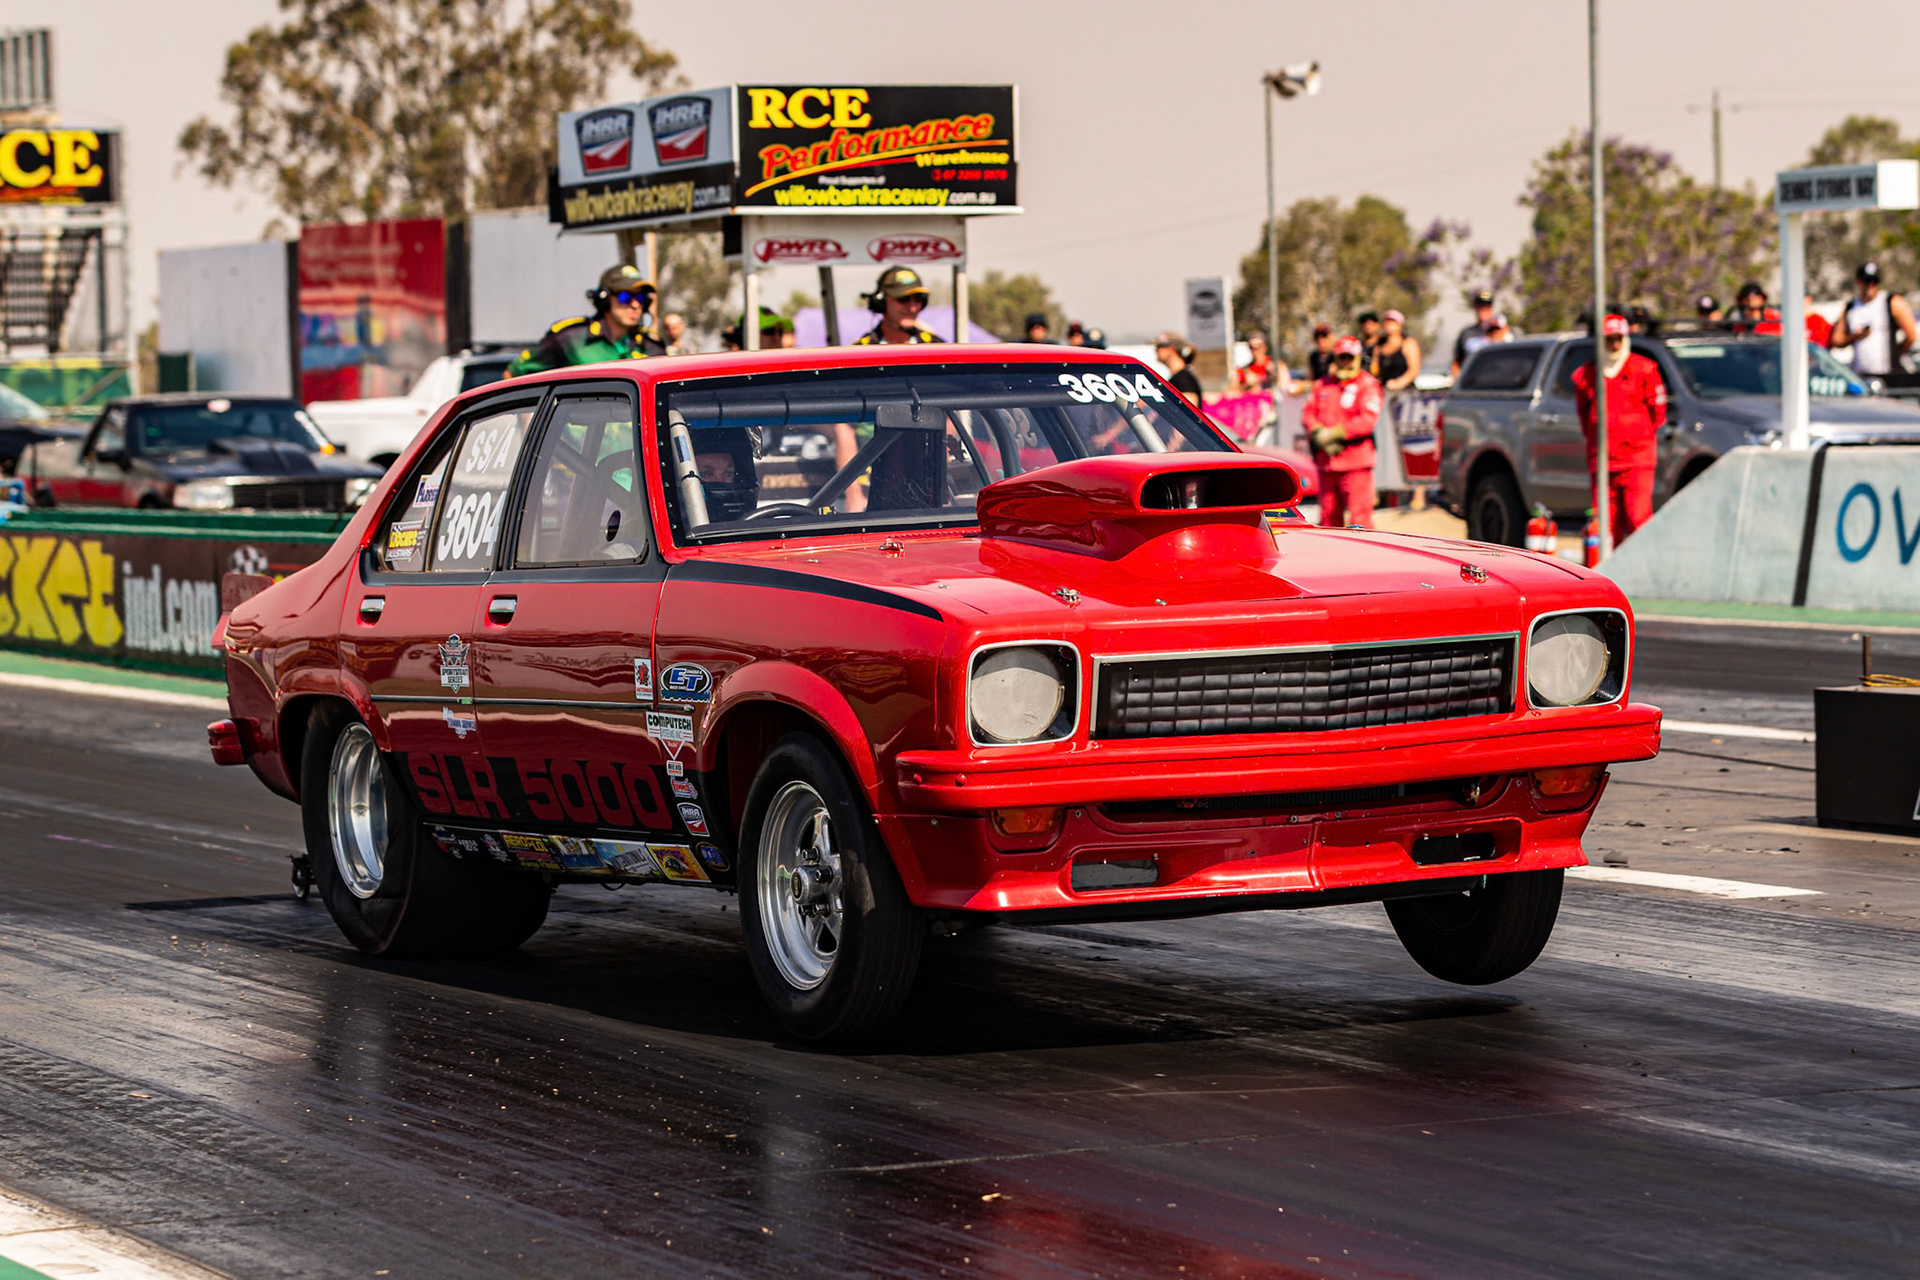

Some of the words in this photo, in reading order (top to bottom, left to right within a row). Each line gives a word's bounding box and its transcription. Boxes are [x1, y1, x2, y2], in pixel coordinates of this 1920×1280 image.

[748, 88, 872, 130] RCE
[0, 129, 103, 188] CE
[759, 113, 995, 180] Performance
[915, 150, 1010, 168] Warehouse
[774, 184, 997, 207] willowbankraceway.com.au
[1058, 373, 1165, 403] 3604
[465, 426, 515, 473] SS/A
[438, 490, 507, 562] 3604
[670, 668, 704, 691] ET
[647, 714, 692, 731] COMPUTECH
[407, 751, 510, 819] SLR
[514, 756, 674, 830] 5000
[681, 806, 700, 817] IHRA
